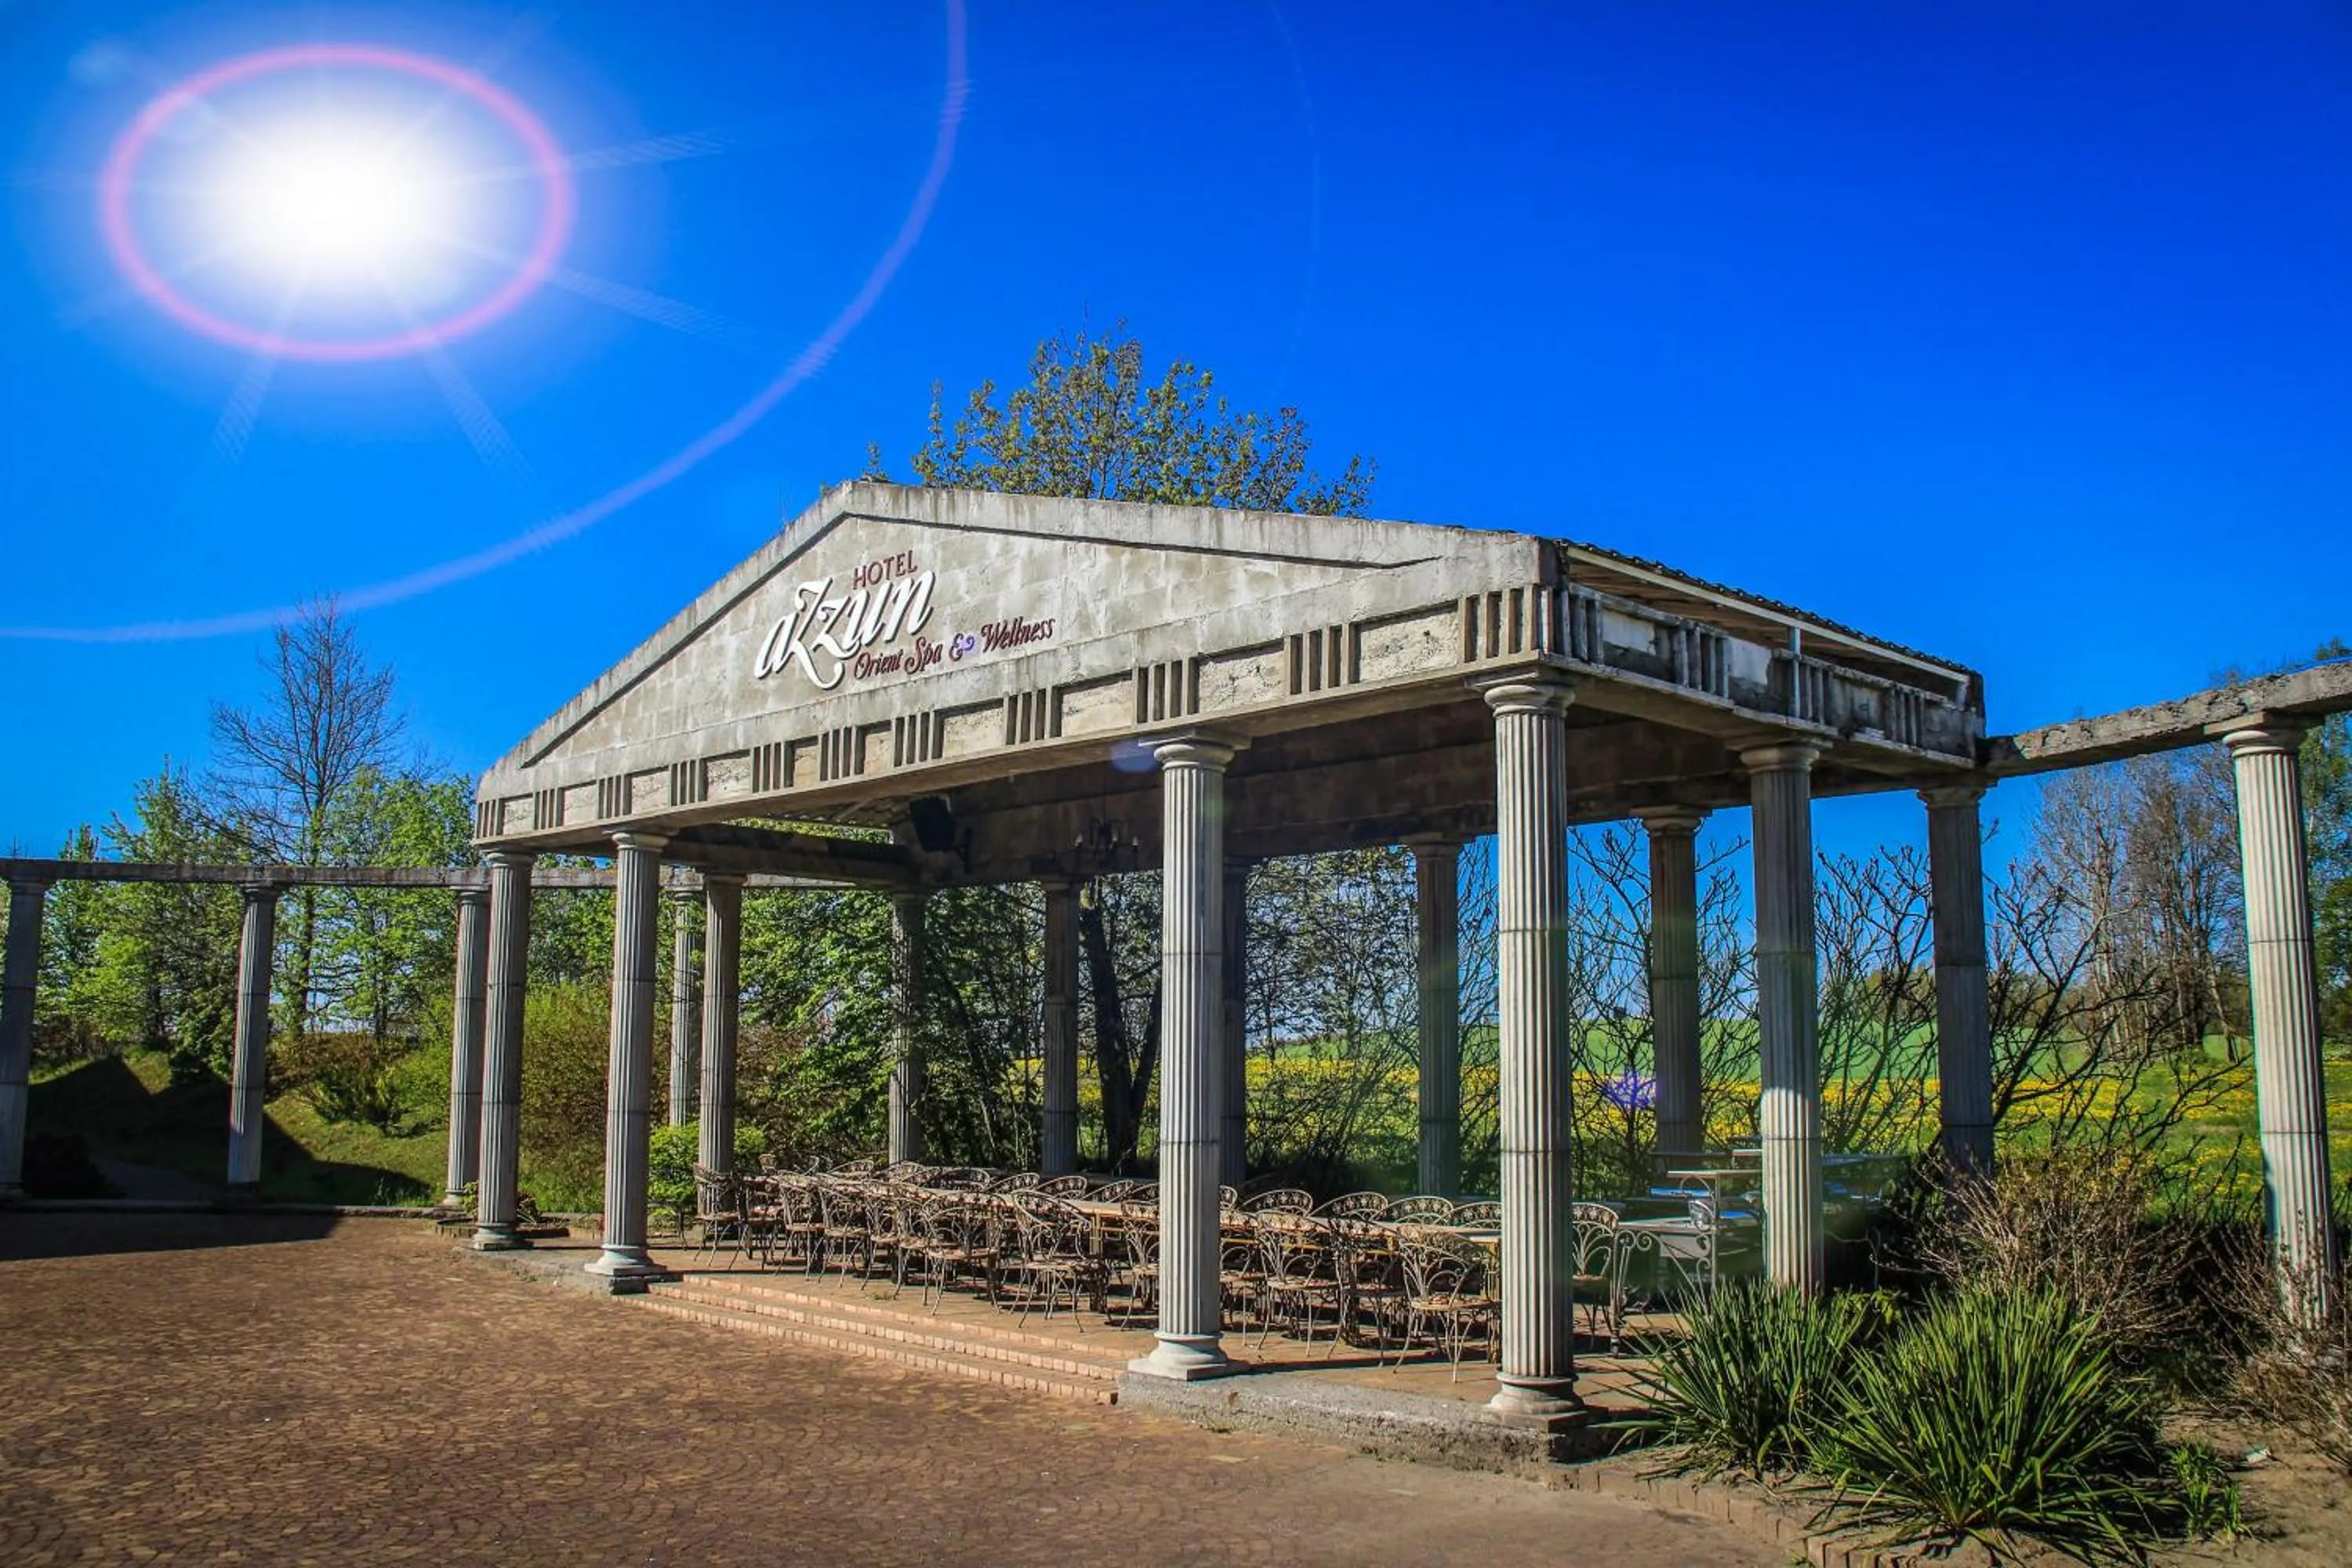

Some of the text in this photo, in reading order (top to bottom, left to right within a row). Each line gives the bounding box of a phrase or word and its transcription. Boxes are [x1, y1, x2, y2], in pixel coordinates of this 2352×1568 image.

[853, 550, 917, 590] HOTEL
[854, 616, 1056, 680] Orient Spa & Wellness
